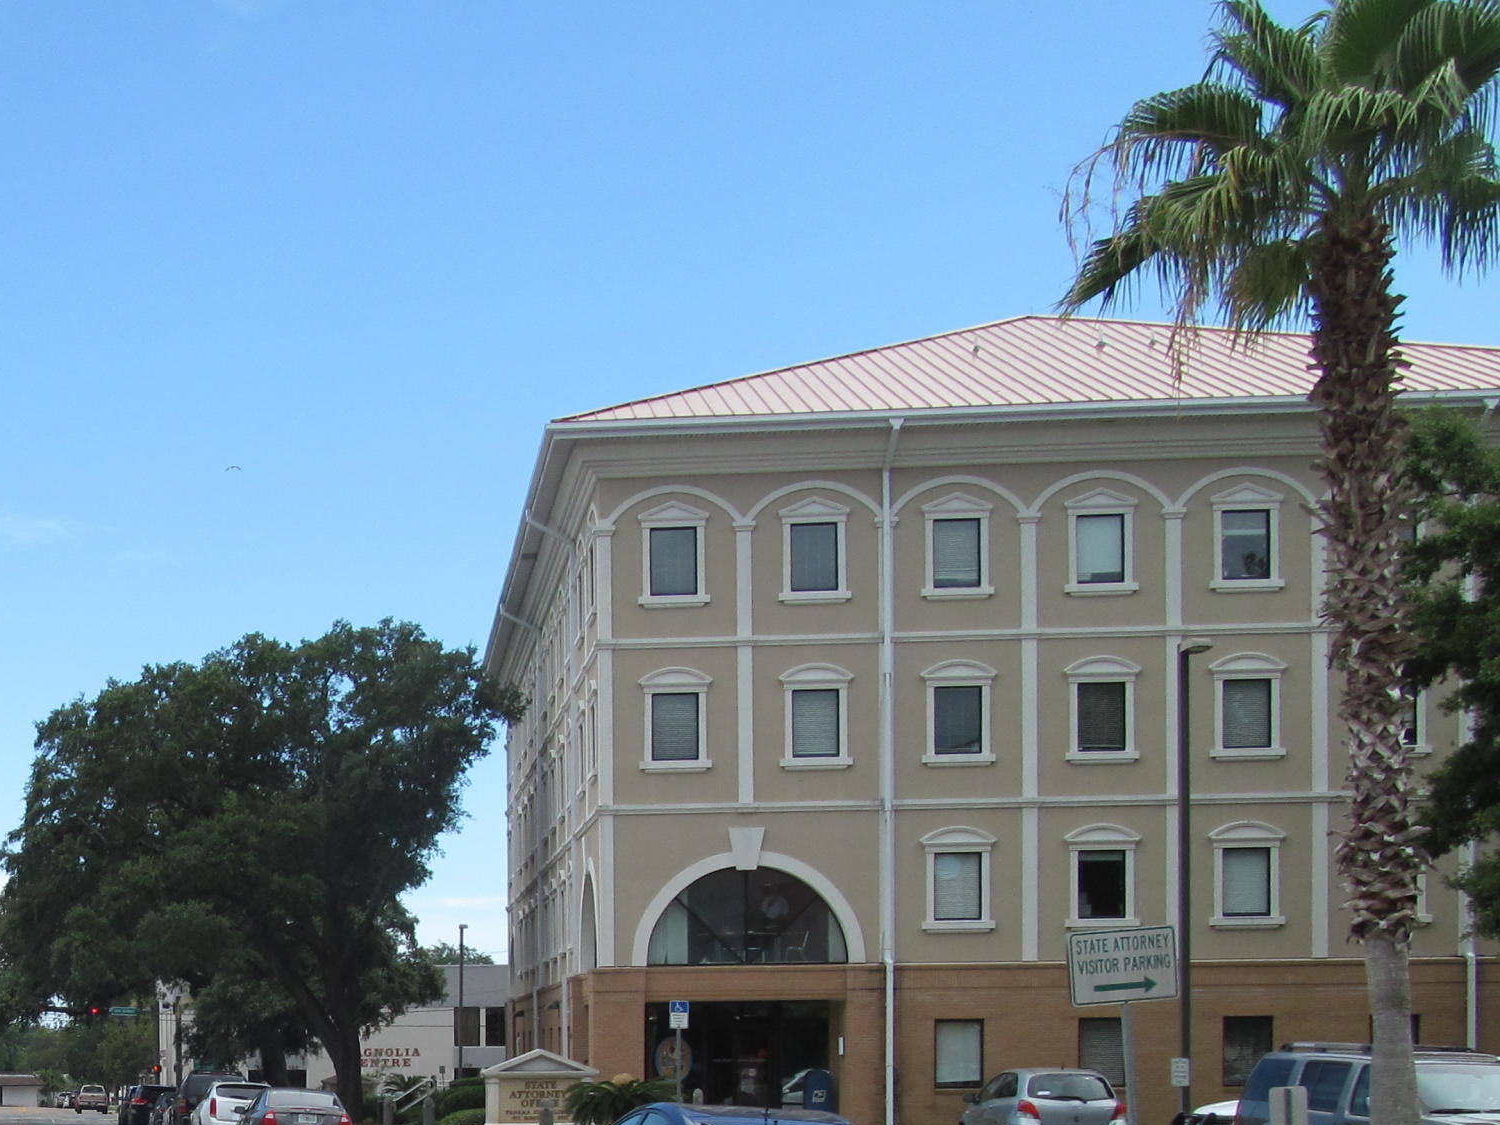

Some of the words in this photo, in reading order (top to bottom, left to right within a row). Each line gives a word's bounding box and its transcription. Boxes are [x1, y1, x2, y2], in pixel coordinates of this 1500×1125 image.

[1076, 938, 1109, 955] STATE
[1114, 933, 1169, 952] ATTORNEY
[1077, 957, 1120, 976] VISITOR
[1124, 954, 1171, 972] PARKING
[360, 1047, 421, 1057] GNOLIA
[360, 1058, 411, 1067] ENTRE
[525, 1080, 557, 1089] STATE
[509, 1090, 566, 1099] ATTORNEY
[521, 1099, 560, 1108] OFFE
